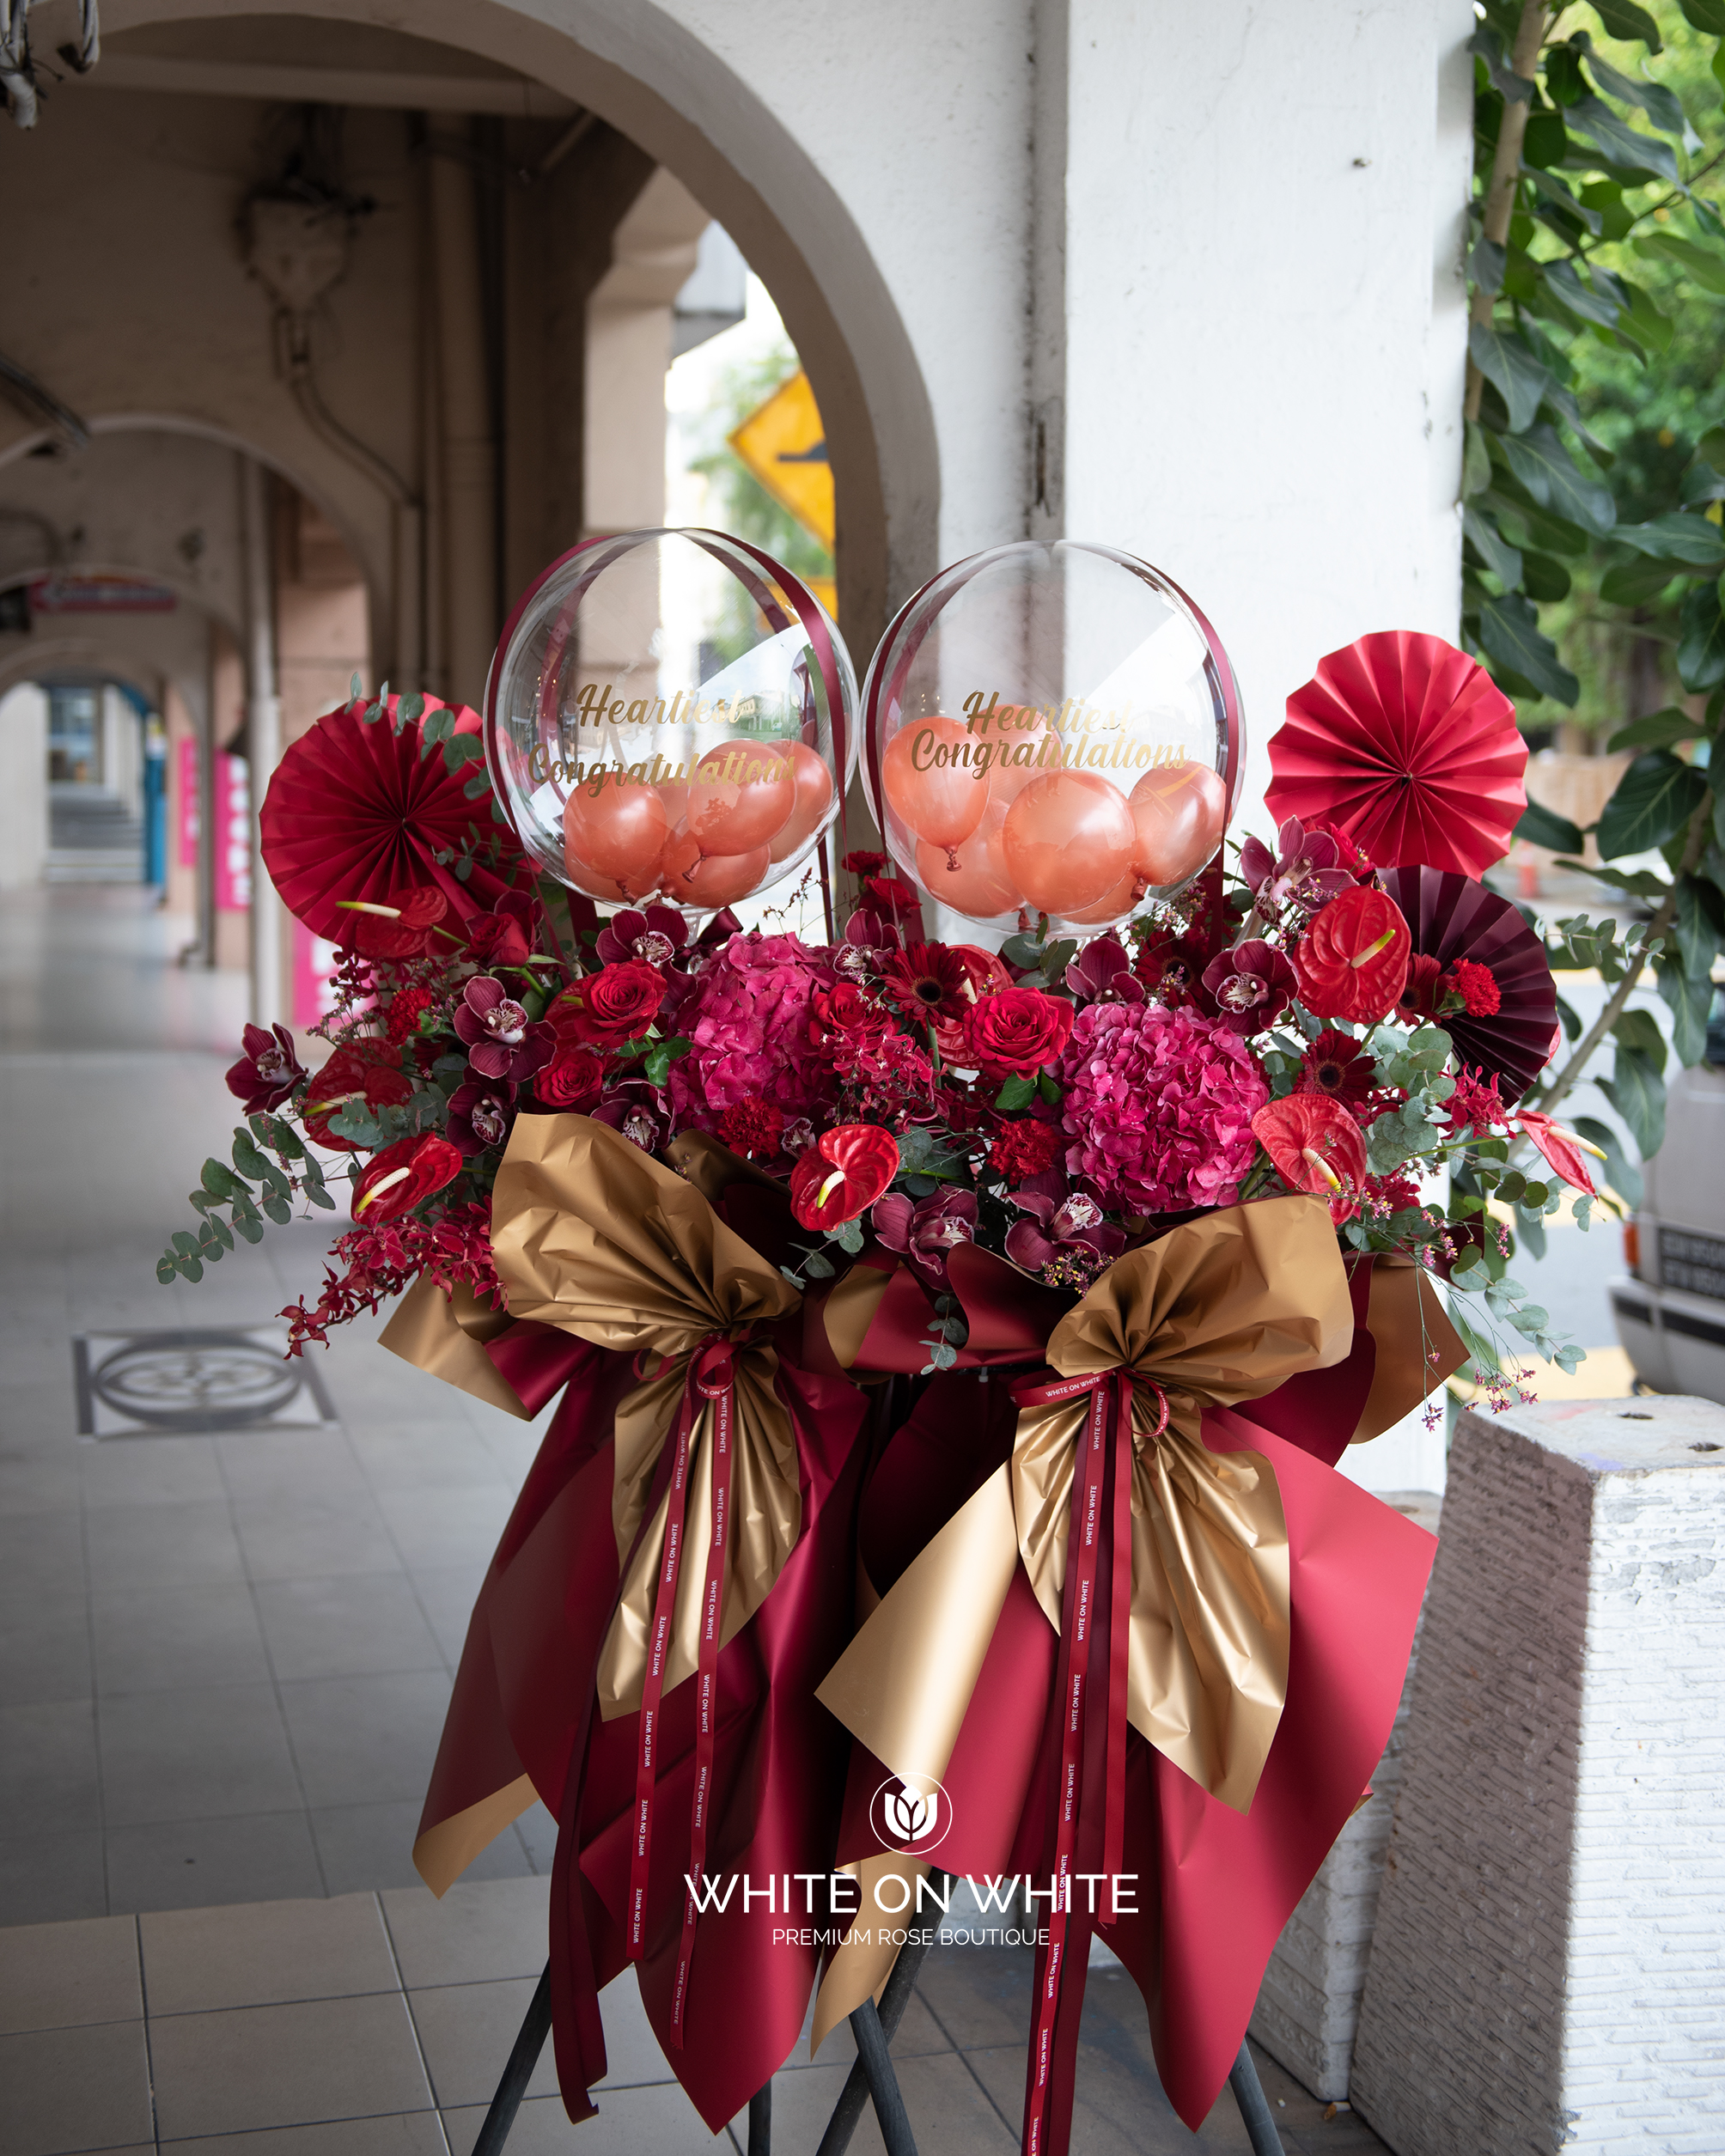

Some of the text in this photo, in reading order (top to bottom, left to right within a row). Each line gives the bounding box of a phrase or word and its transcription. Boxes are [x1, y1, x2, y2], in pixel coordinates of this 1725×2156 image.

[576, 684, 745, 727] Heartiest
[962, 690, 1134, 734] Heartiest
[911, 728, 1191, 780] Congratulations
[527, 743, 799, 798] Congratulations
[1045, 1376, 1100, 1398] WHITE ON WHITE
[1096, 1391, 1105, 1413] WHITE
[721, 1419, 727, 1430] ON
[1095, 1414, 1101, 1425] ON
[679, 1455, 685, 1465] ON
[716, 1512, 723, 1522] ON
[1088, 1509, 1094, 1520] ON
[665, 1523, 679, 1582] WHITE ON WHITE
[1081, 1580, 1089, 1603] WHITE
[706, 1580, 717, 1640] WHITE ON WHITE
[1079, 1605, 1086, 1617] ON
[652, 1616, 667, 1676] WHITE ON WHITE
[703, 1699, 709, 1709] ON
[1072, 1697, 1079, 1708] ON
[645, 1734, 651, 1745] ON
[698, 1791, 704, 1803] ON
[1066, 1788, 1073, 1799] ON
[639, 1823, 646, 1833] ON
[1059, 1877, 1065, 1888] ON
[634, 1911, 641, 1922] ON
[1050, 1964, 1056, 1975] ON
[676, 1987, 682, 1999] ON
[1040, 2052, 1045, 2063] ON
[1032, 2140, 1036, 2151] ON
